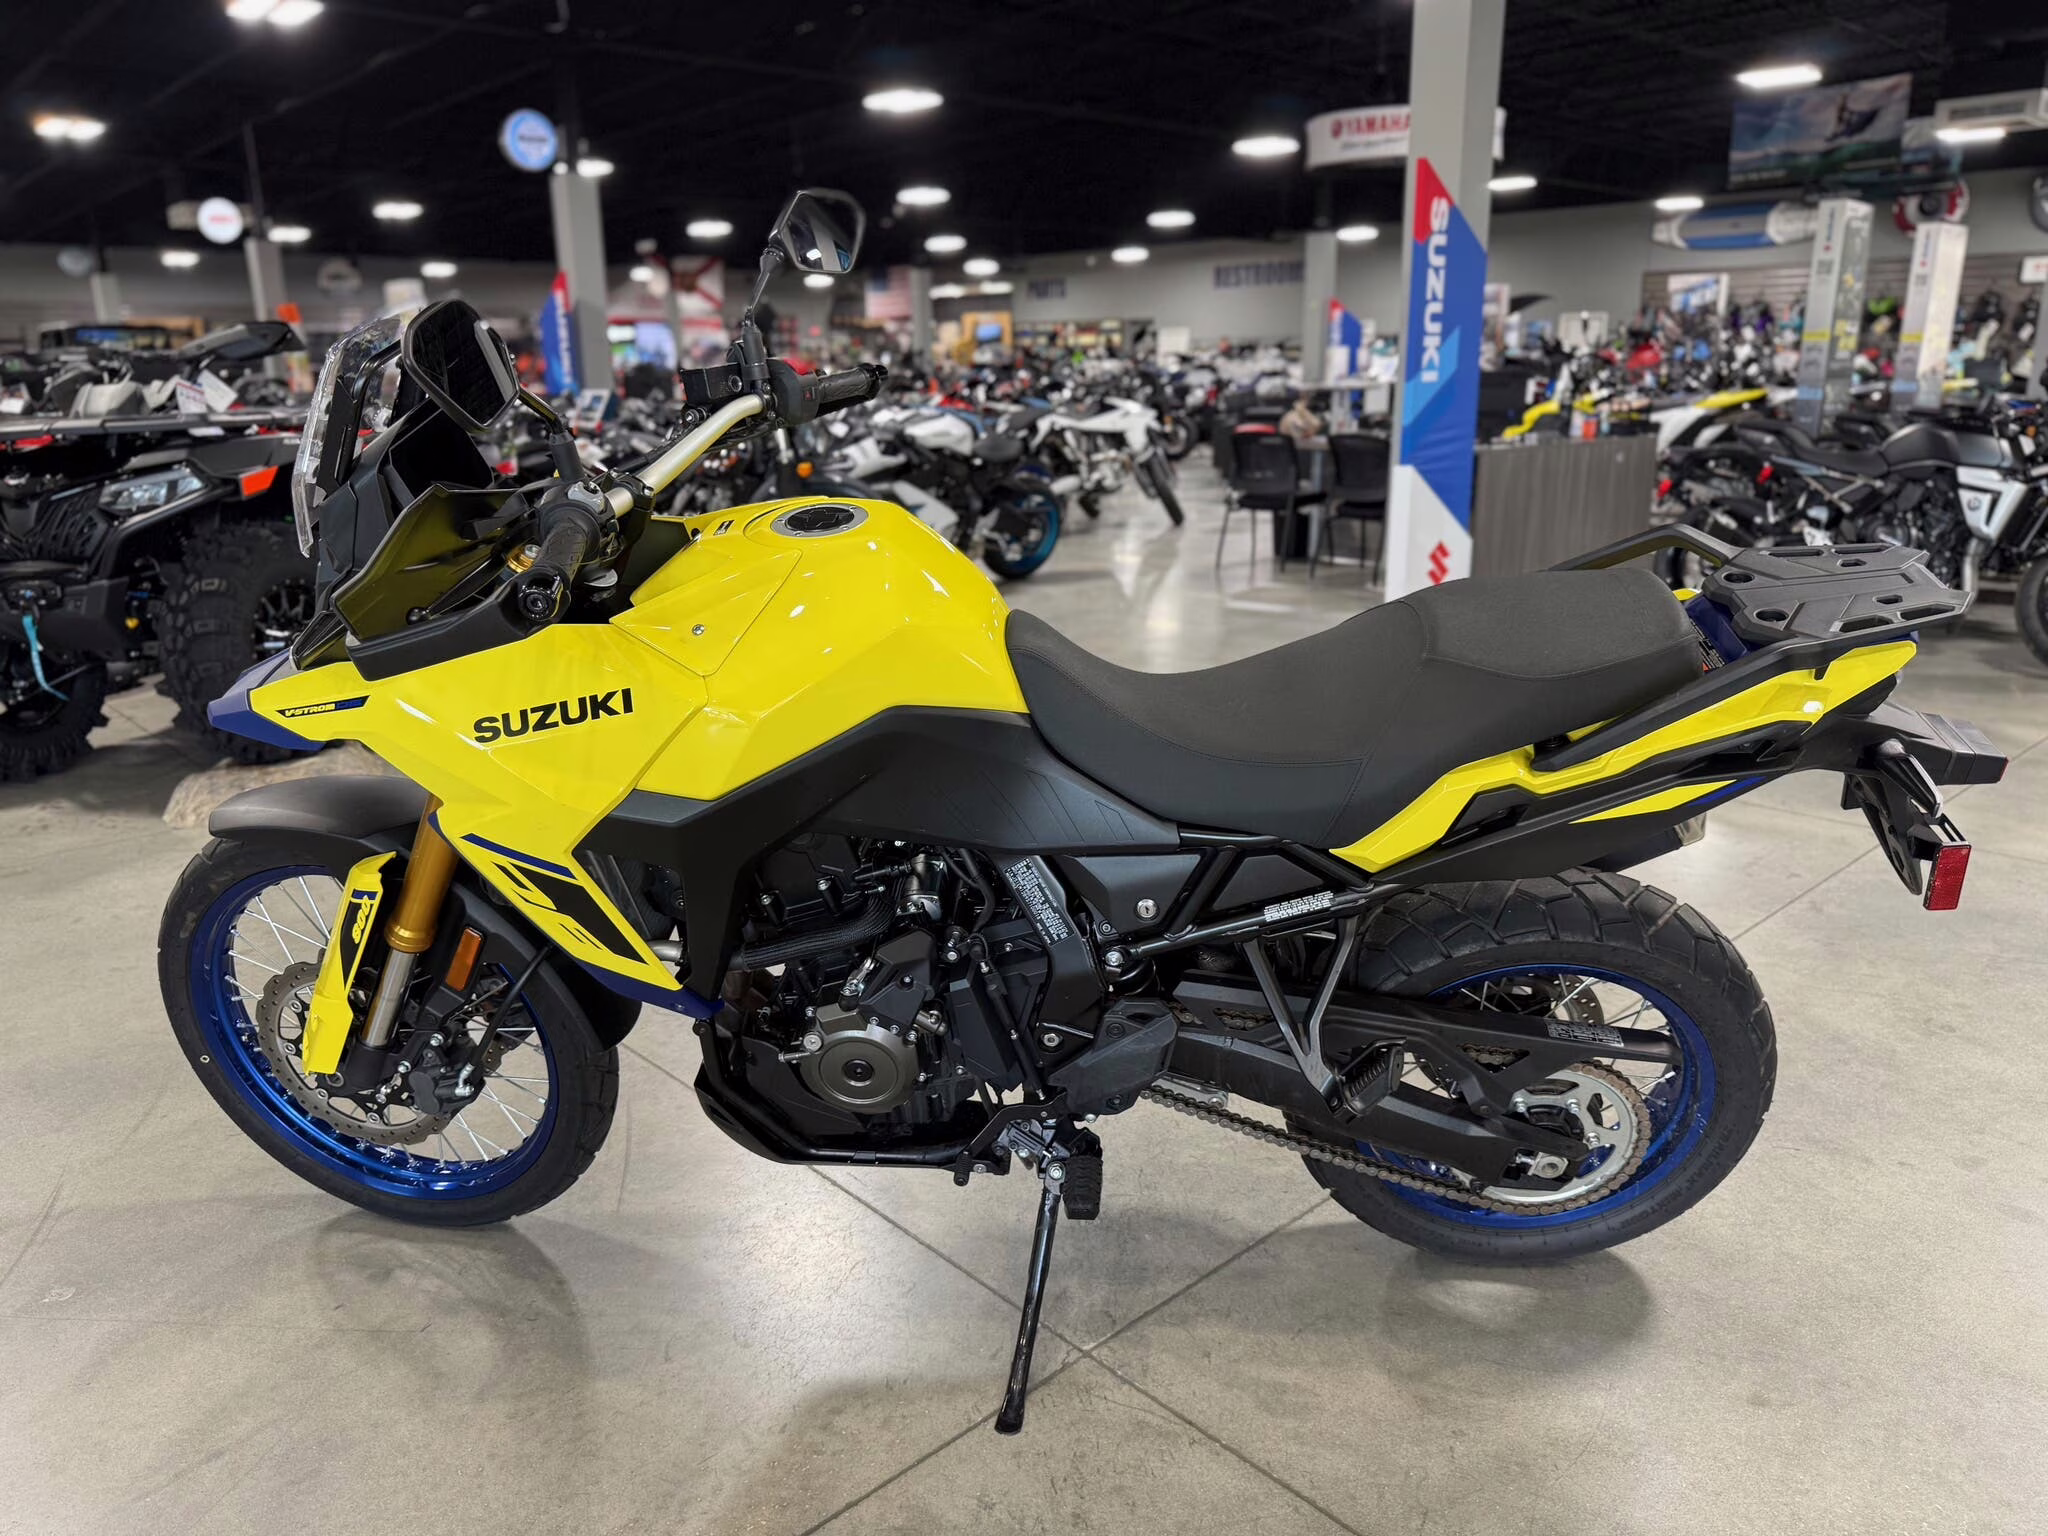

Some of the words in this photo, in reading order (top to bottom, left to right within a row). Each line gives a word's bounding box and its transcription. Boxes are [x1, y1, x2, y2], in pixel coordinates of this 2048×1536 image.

[1420, 196, 1450, 384] SUZUKI
[284, 702, 336, 717] V-STROM
[473, 687, 634, 744] SUZUKI
[351, 894, 371, 945] 800
